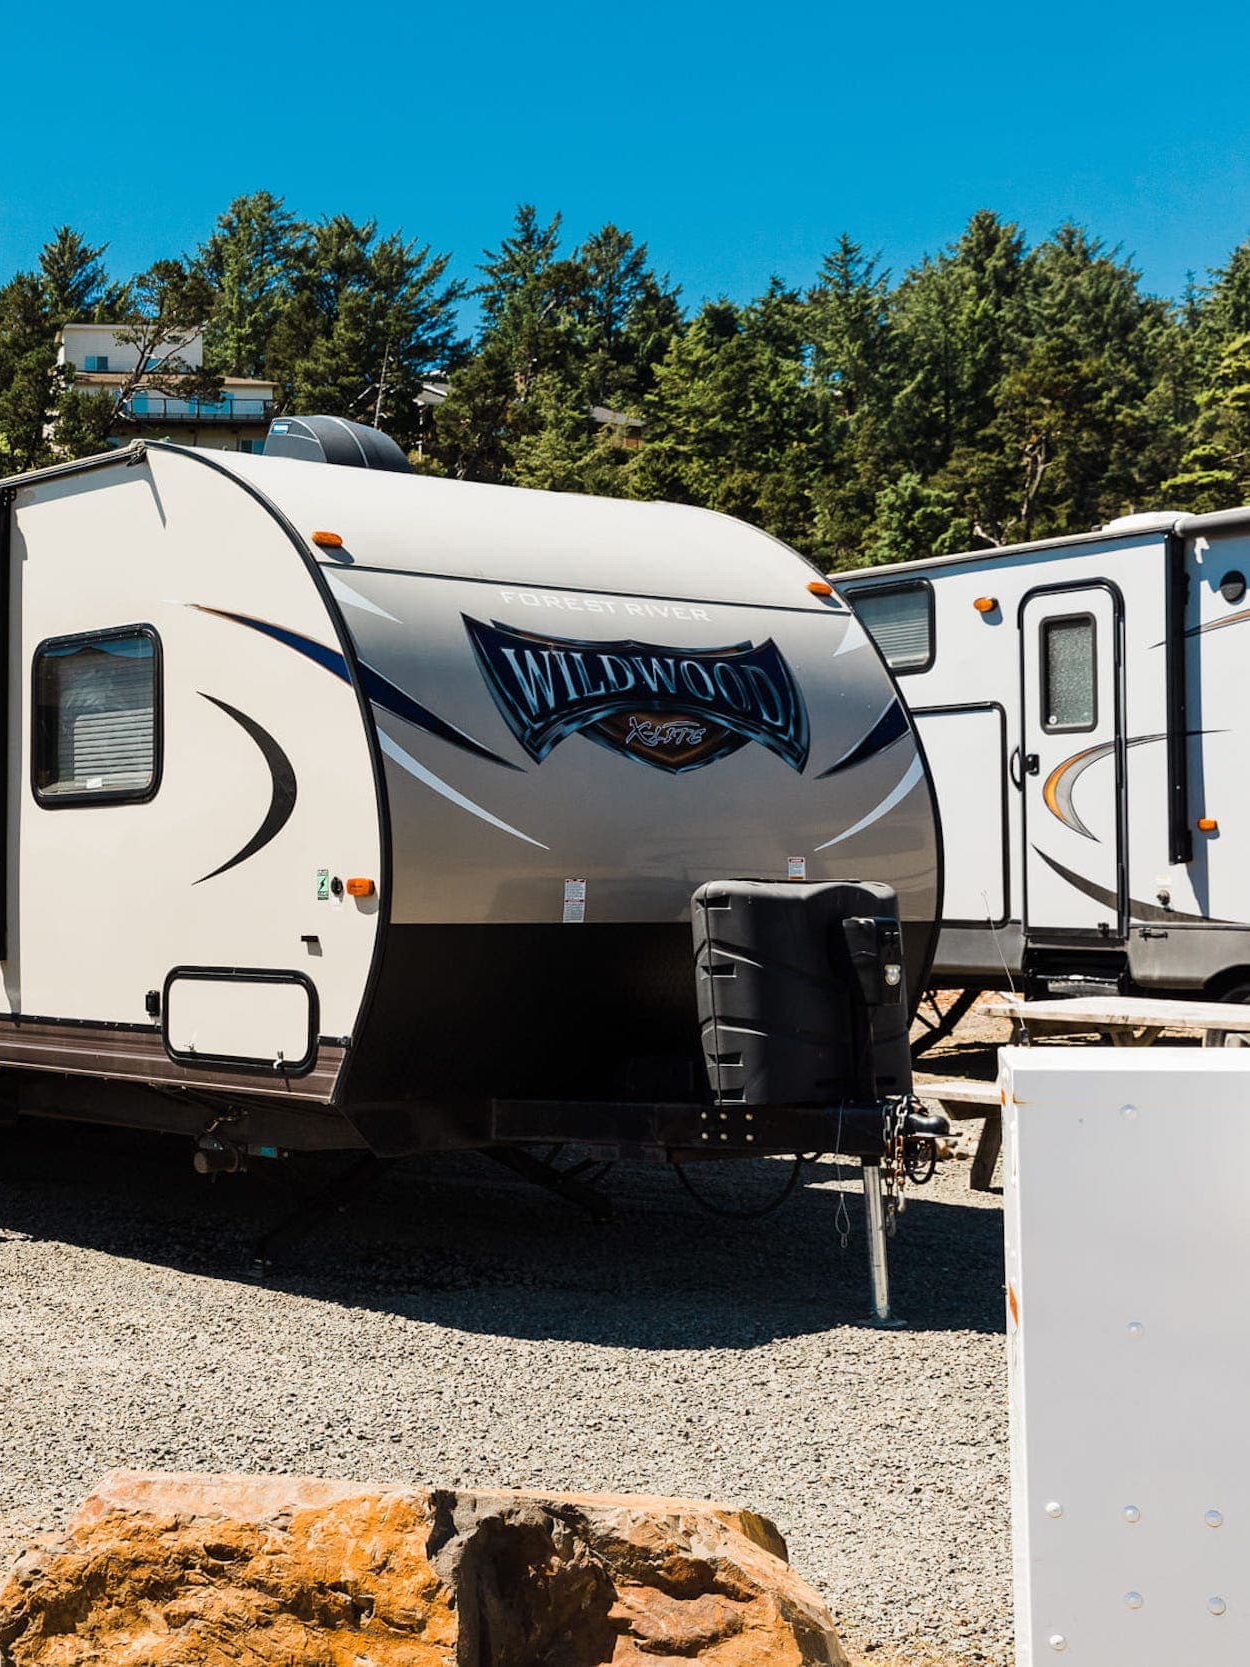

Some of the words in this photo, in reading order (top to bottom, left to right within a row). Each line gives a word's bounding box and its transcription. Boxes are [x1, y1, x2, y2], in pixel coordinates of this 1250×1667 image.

[500, 590, 616, 615] FOREST
[625, 602, 714, 622] RIVER
[500, 648, 786, 728] WILDWOOD
